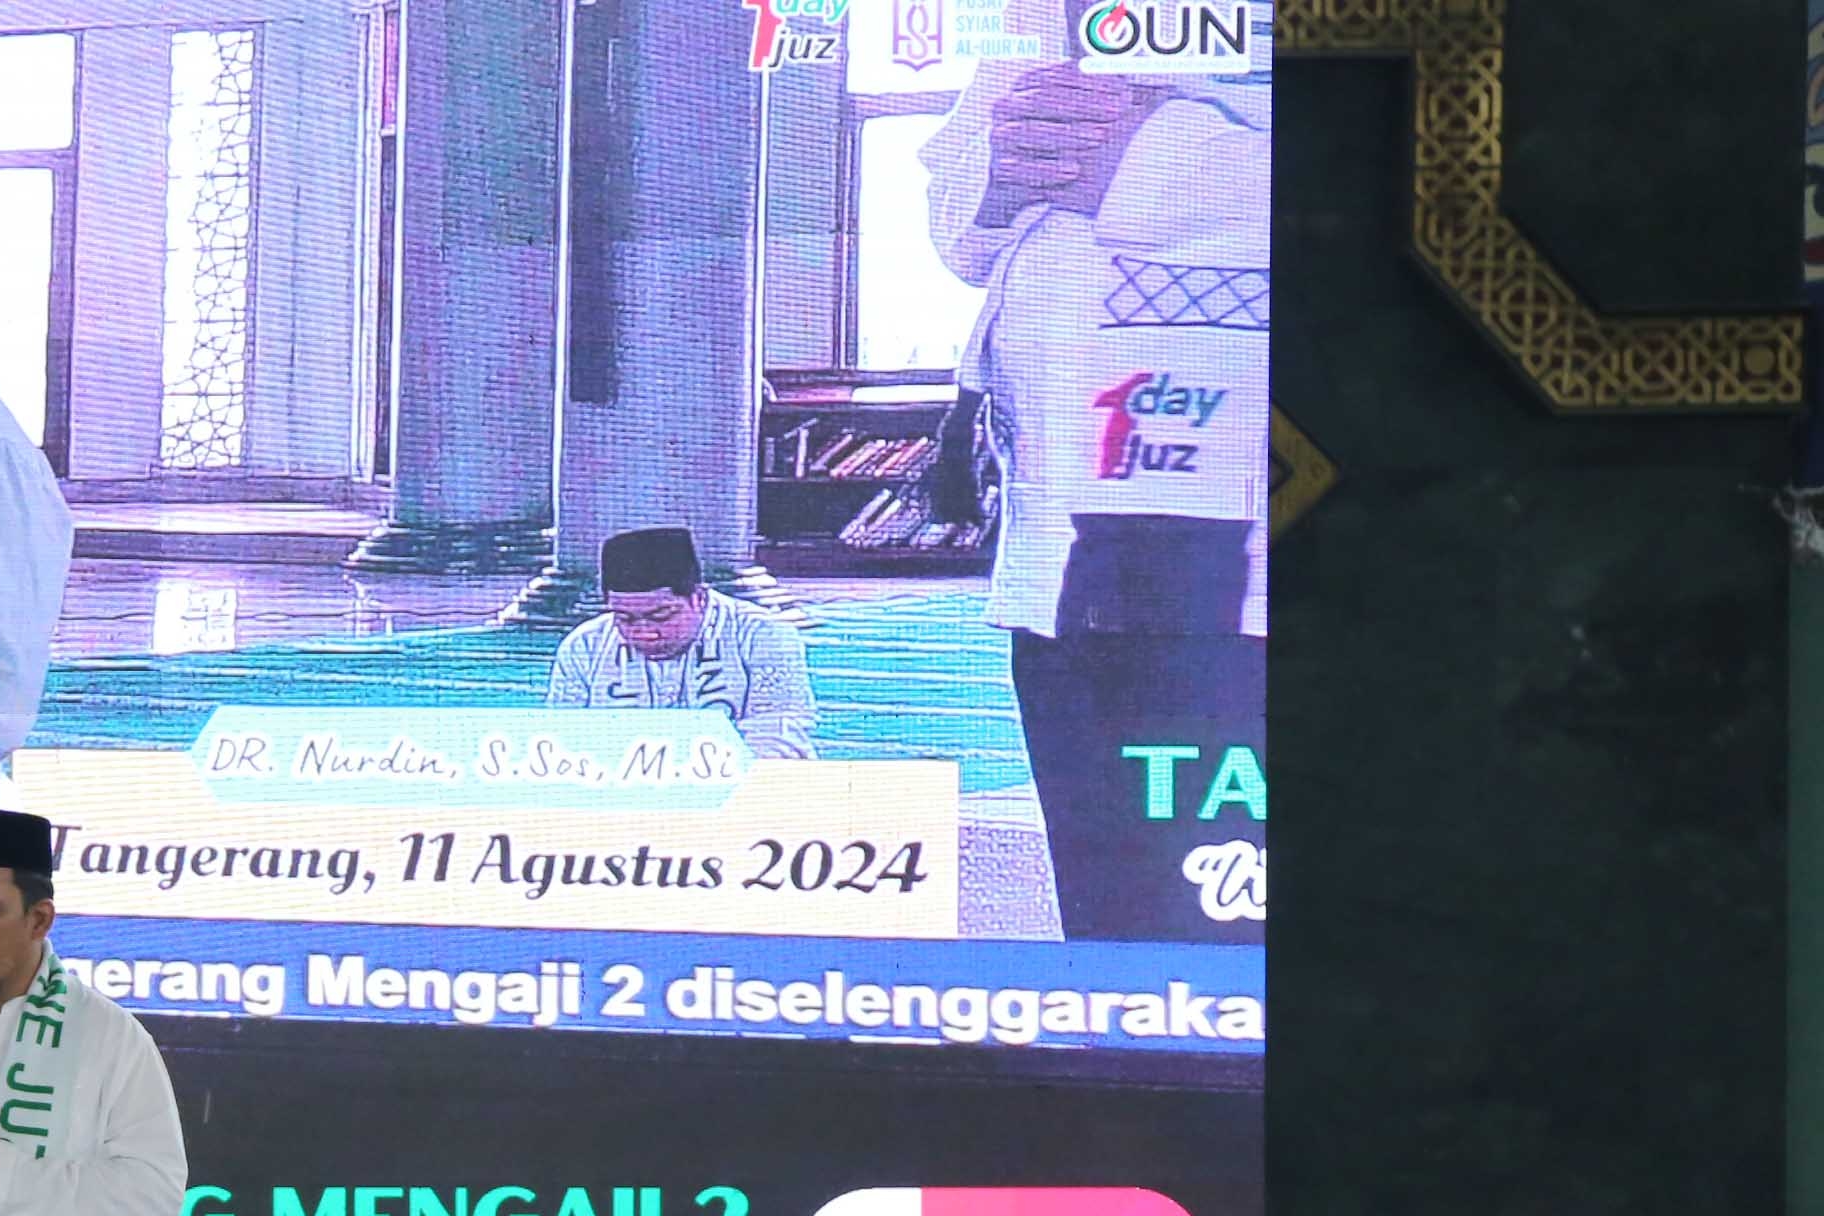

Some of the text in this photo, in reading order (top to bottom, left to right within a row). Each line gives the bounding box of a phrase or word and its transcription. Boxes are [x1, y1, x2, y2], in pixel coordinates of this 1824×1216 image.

[956, 16, 1000, 31] SYIAR
[769, 32, 837, 67] juz
[1126, 373, 1228, 427] day
[1117, 434, 1199, 479] juz
[210, 737, 734, 784] DR. Nurdin, S.Sos, M.Si
[1121, 745, 1266, 820] TA
[50, 824, 929, 900] Tangerang, 11 Agustus 2024
[308, 954, 581, 1026] Mengaji
[601, 964, 646, 1017] 2
[666, 967, 1265, 1043] diselenggaraka
